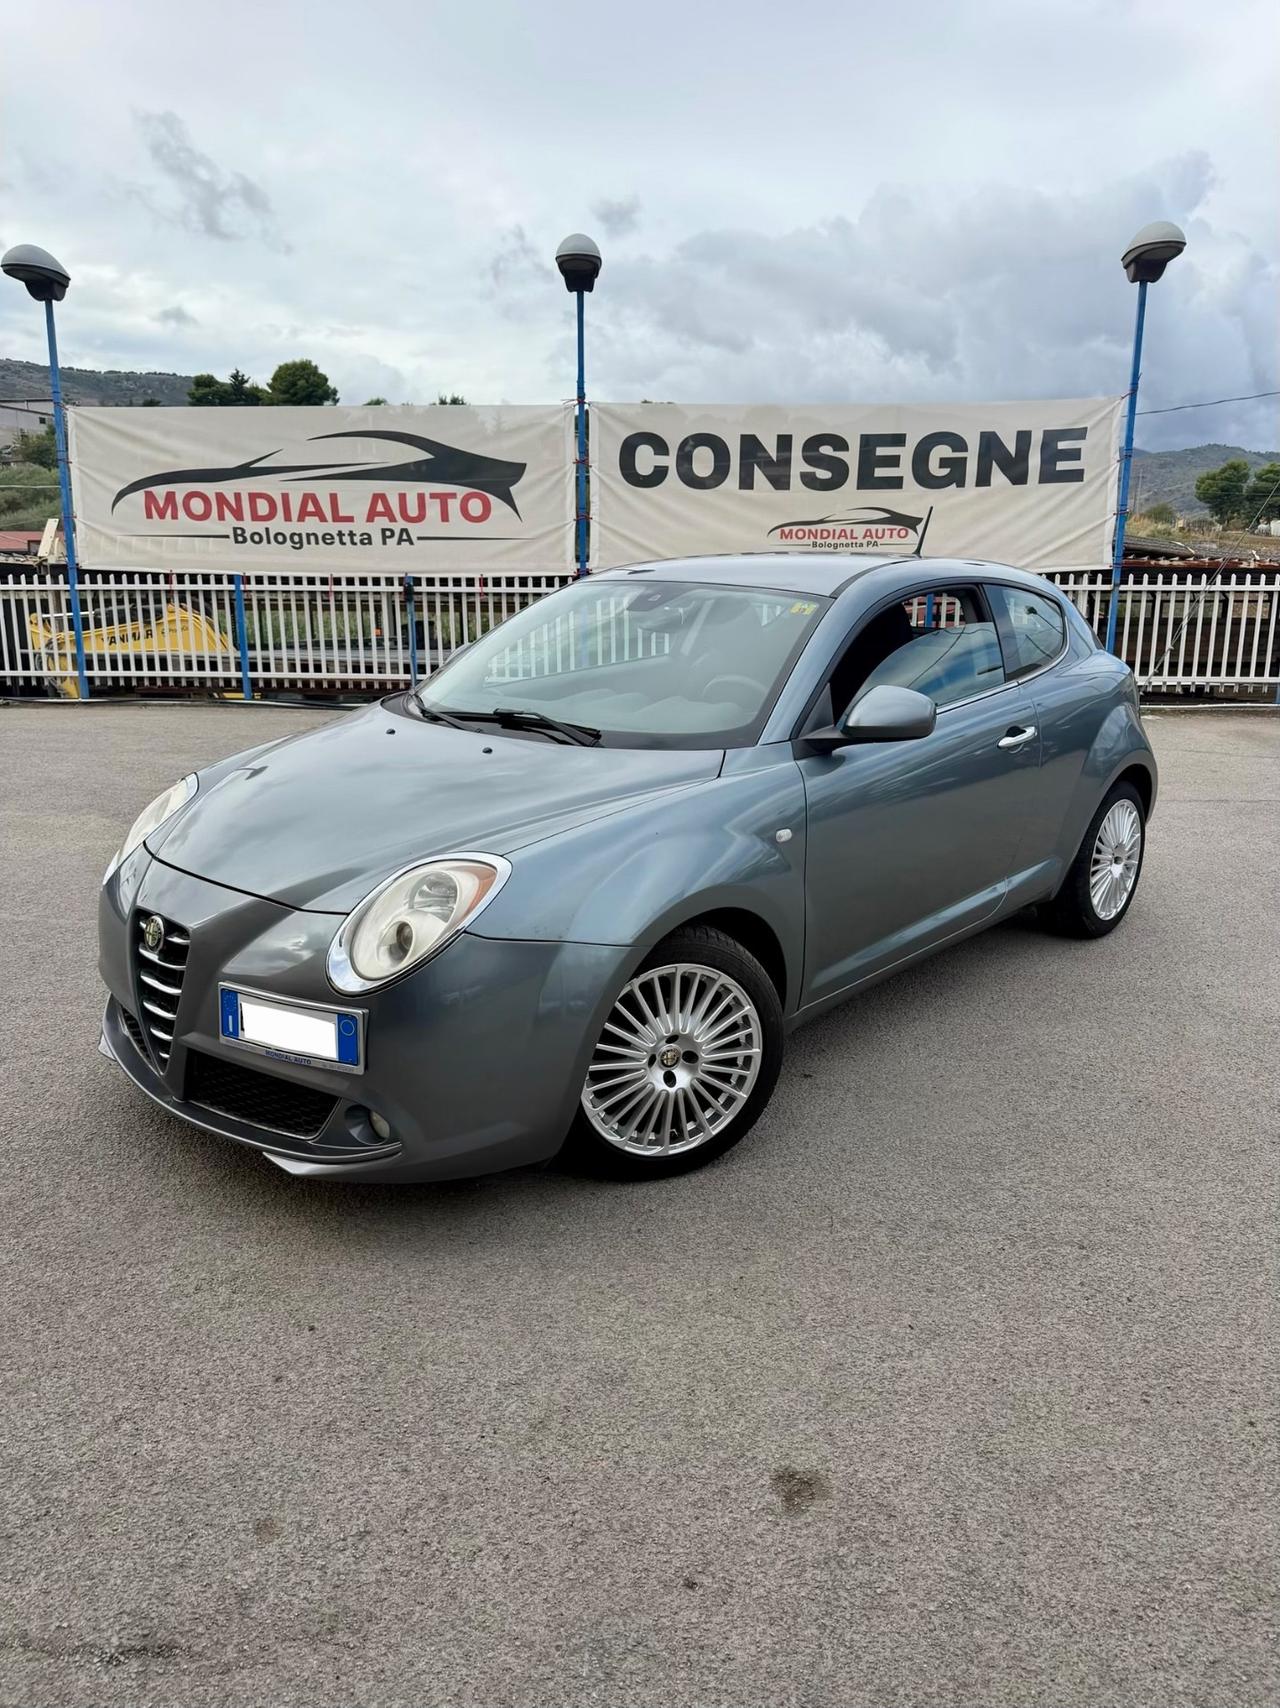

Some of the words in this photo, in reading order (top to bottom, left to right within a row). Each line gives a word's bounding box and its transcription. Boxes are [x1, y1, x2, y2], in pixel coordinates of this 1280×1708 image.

[619, 426, 1088, 492] CONSEGNE
[144, 490, 355, 523] MONDIAL
[365, 491, 492, 523] AUTO
[232, 526, 373, 550] Bolognetta
[381, 527, 415, 546] PA
[779, 528, 858, 540] MONDIAL
[862, 527, 909, 540] AUTO
[811, 541, 864, 550] Bolognetta
[866, 540, 879, 548] PA
[265, 1050, 293, 1062] MONDIAL
[294, 1057, 312, 1065] AUTO
